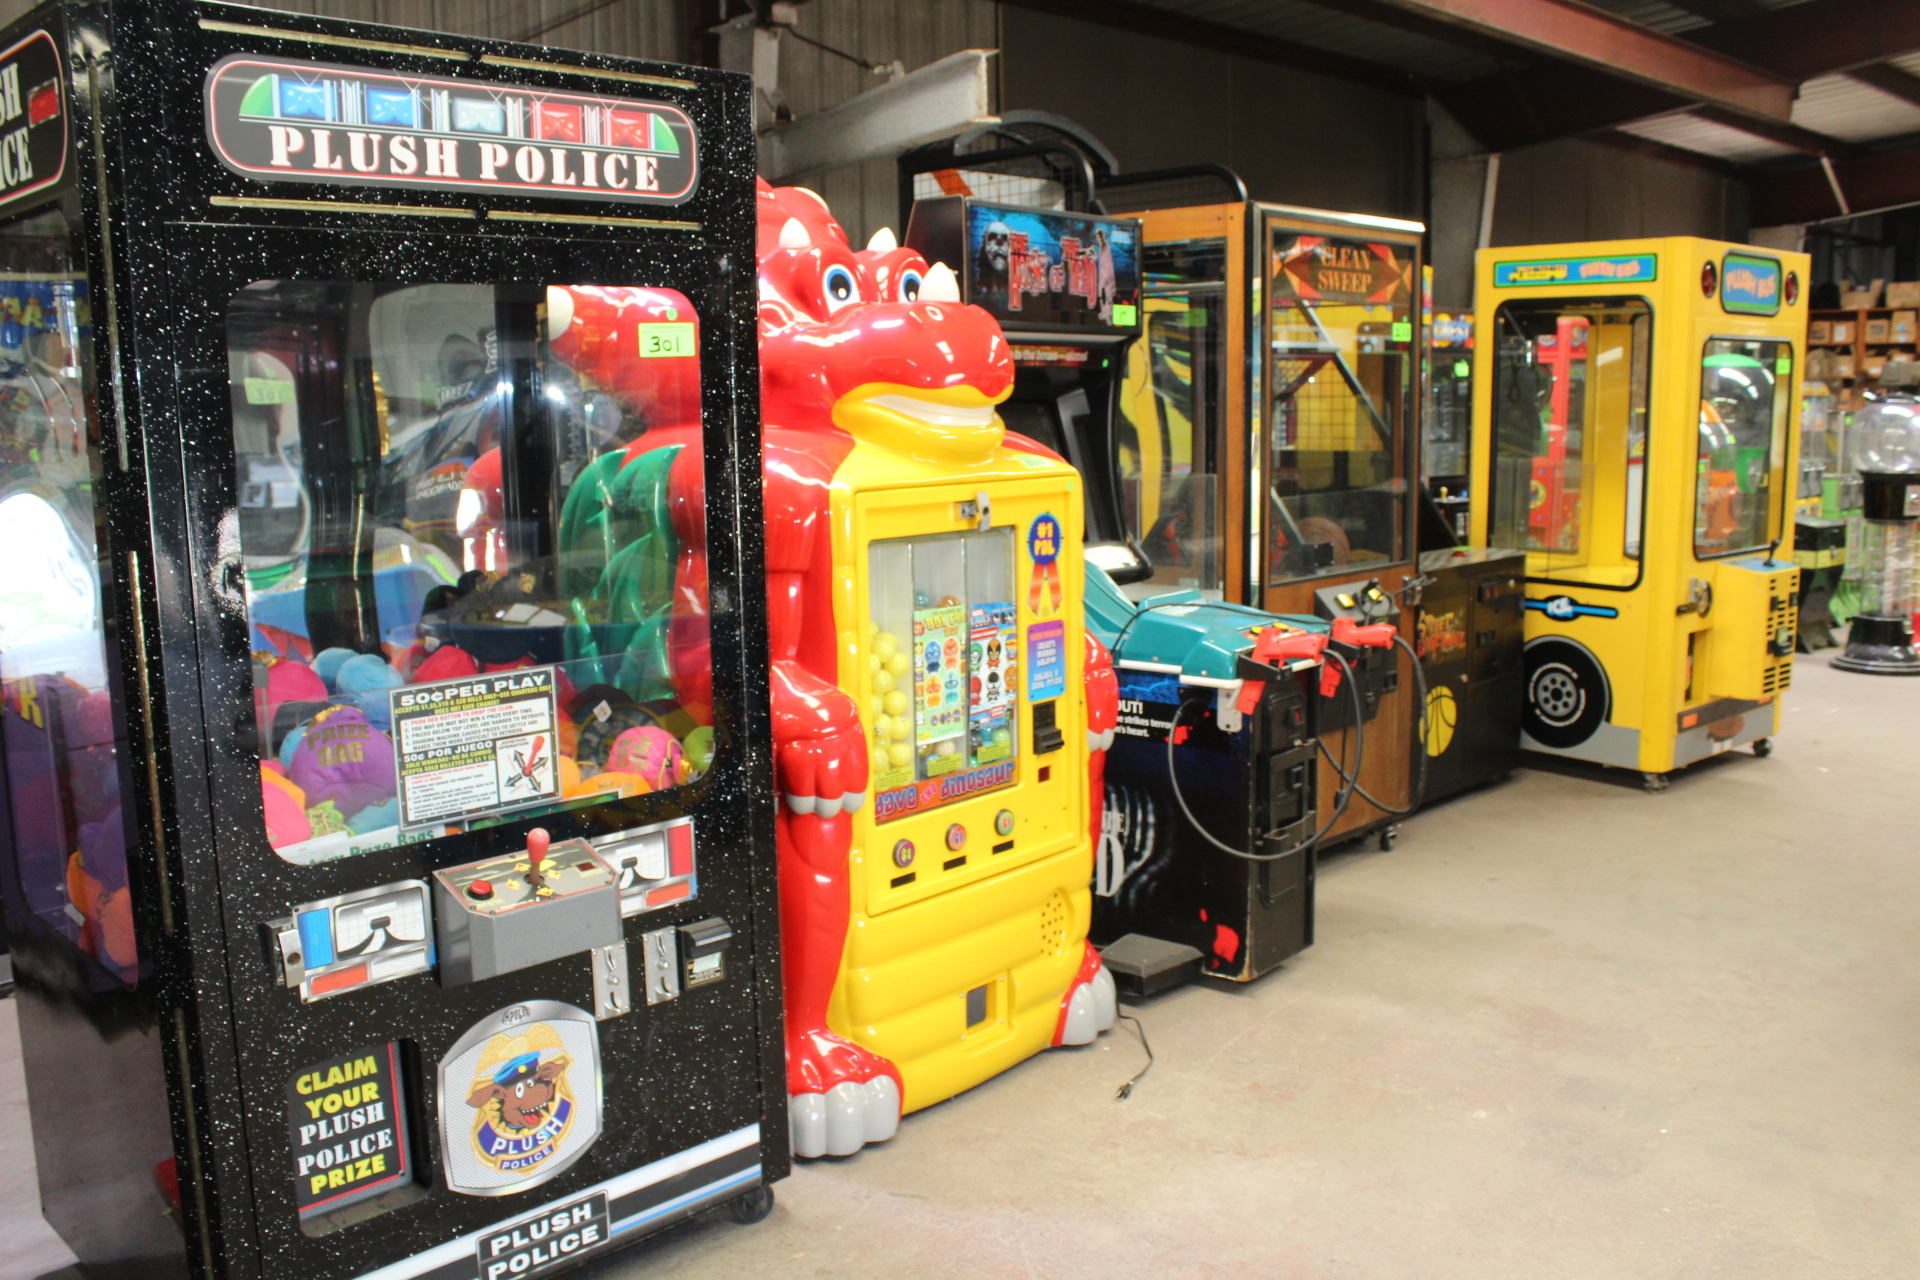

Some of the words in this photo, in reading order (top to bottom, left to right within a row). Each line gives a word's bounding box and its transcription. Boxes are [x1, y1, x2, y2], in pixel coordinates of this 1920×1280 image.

[268, 125, 460, 178] PLUSH
[479, 142, 659, 192] POLICE
[1320, 246, 1371, 270] CLEAN
[1317, 269, 1373, 293] SWEEP
[1726, 268, 1757, 296] PLUSH
[1757, 274, 1776, 298] BUS
[649, 335, 680, 353] 301
[494, 674, 546, 692] PLAY
[394, 705, 420, 715] ACCEPTS
[511, 687, 538, 697] QUARTERS
[434, 706, 449, 715] DOES
[450, 704, 461, 712] NOT
[462, 702, 475, 711] GIVE
[471, 708, 485, 716] DROP
[432, 728, 450, 736] BELOW
[463, 723, 480, 731] LEVEL
[1150, 719, 1174, 729] terro
[307, 723, 371, 751] PRIZE
[412, 737, 435, 745] SHAKING
[436, 733, 460, 741] MACHINE
[461, 729, 481, 737] CAUSES
[432, 740, 447, 748] THEM
[448, 737, 464, 745] MORE
[464, 733, 490, 742] DIFFICULT
[317, 741, 364, 768] BAG
[427, 747, 452, 759] POR
[454, 740, 494, 754] JUEGO
[401, 767, 423, 776] ACEPTA
[424, 764, 439, 772] SOLO
[439, 759, 466, 769] BILLETES
[405, 760, 420, 769] SOLO
[940, 760, 1015, 800] dinosaur
[901, 846, 912, 863] $1
[296, 1055, 378, 1095] CLAIM
[305, 1081, 380, 1119] YOUR
[299, 1101, 386, 1146] PLUSH
[490, 1116, 564, 1155] PLUSH
[297, 1128, 394, 1177] POLICE
[501, 1146, 552, 1170] POLICE
[310, 1153, 387, 1196] PRIZE
[490, 1203, 593, 1257] PLUSH
[488, 1224, 600, 1280] POLICE
